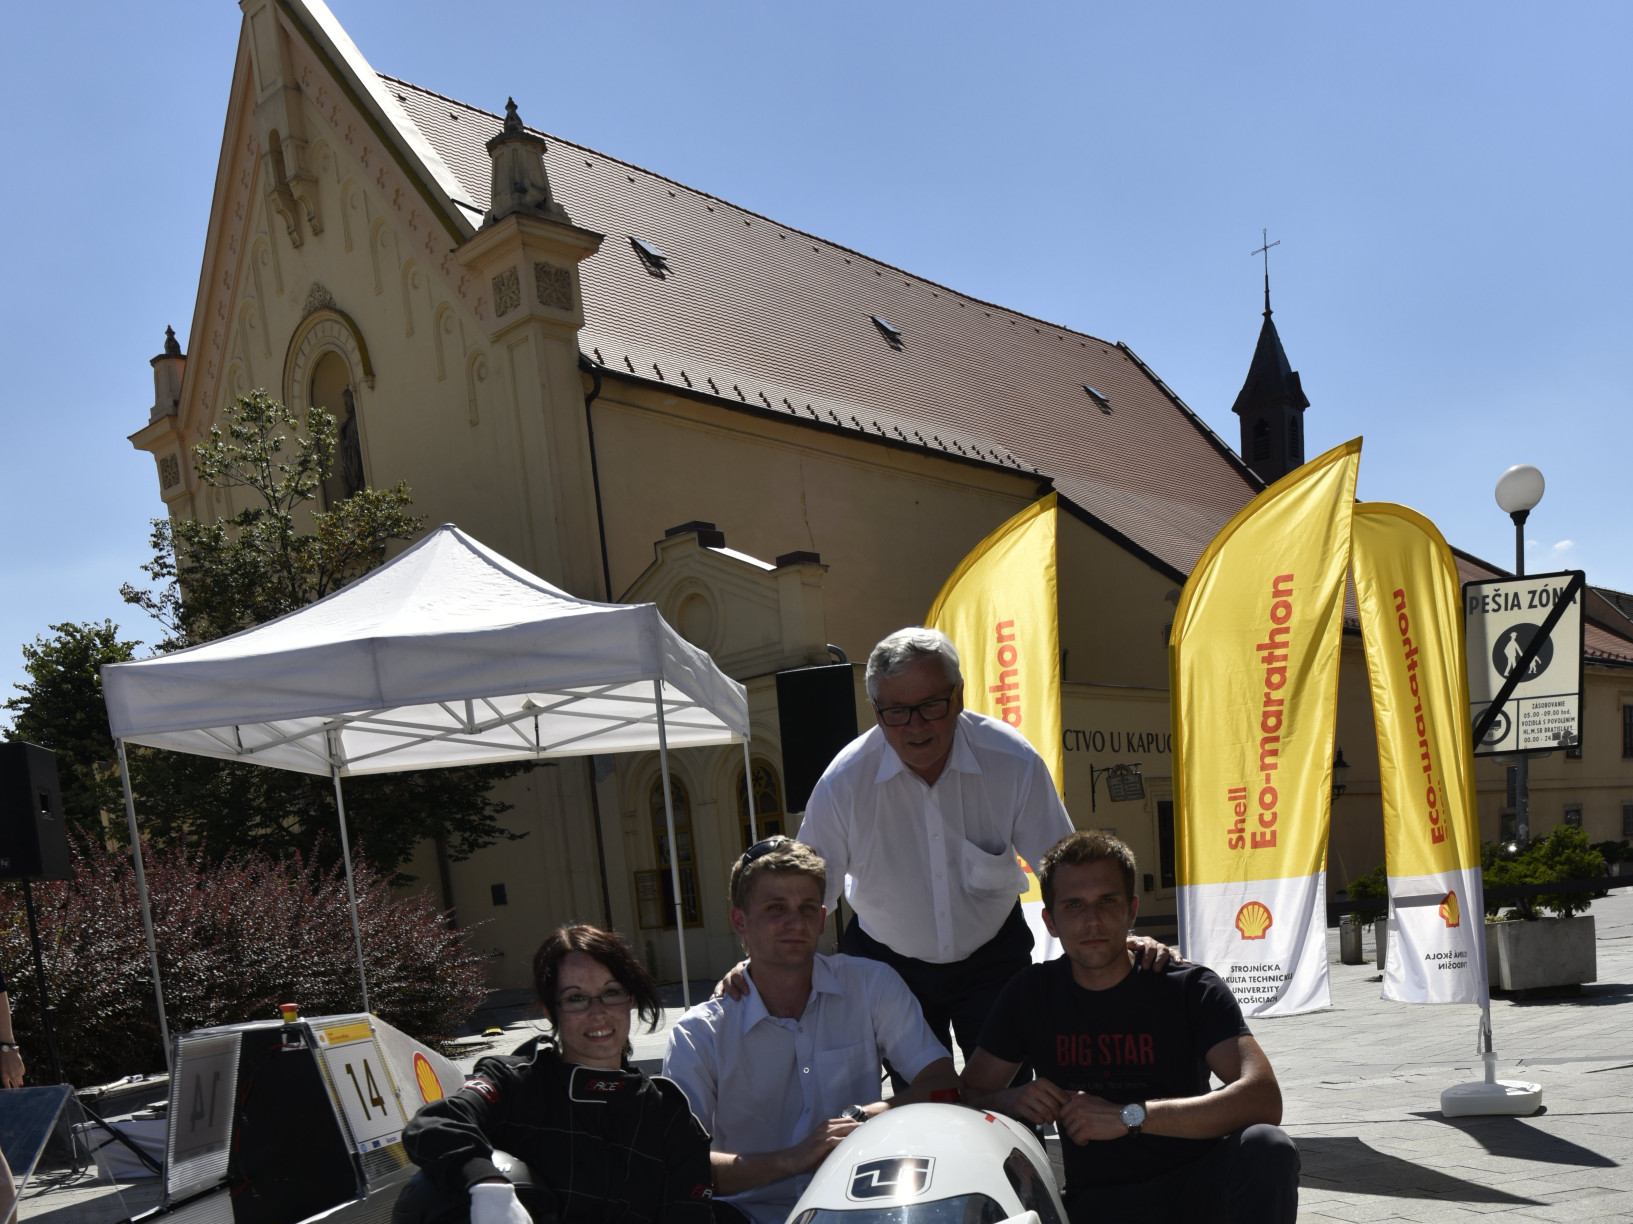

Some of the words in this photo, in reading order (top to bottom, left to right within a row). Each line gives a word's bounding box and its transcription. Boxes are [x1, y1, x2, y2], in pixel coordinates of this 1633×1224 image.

[1469, 588, 1522, 615] PEŠIA
[1251, 573, 1295, 849] Eco-marathon
[1532, 700, 1566, 710] ZÁSOBOVANIE
[1521, 719, 1542, 727] VOZIDLA
[1062, 729, 1106, 752] CTVO
[1110, 731, 1121, 753] U
[1227, 786, 1247, 850] Shell
[1221, 976, 1247, 984] AKULTA
[1230, 963, 1281, 973] STROJNÍCKA
[1232, 985, 1280, 994] UNIVERZITY
[1056, 1033, 1093, 1067] BIG
[1097, 1033, 1155, 1066] STAR
[345, 1058, 387, 1121] 14
